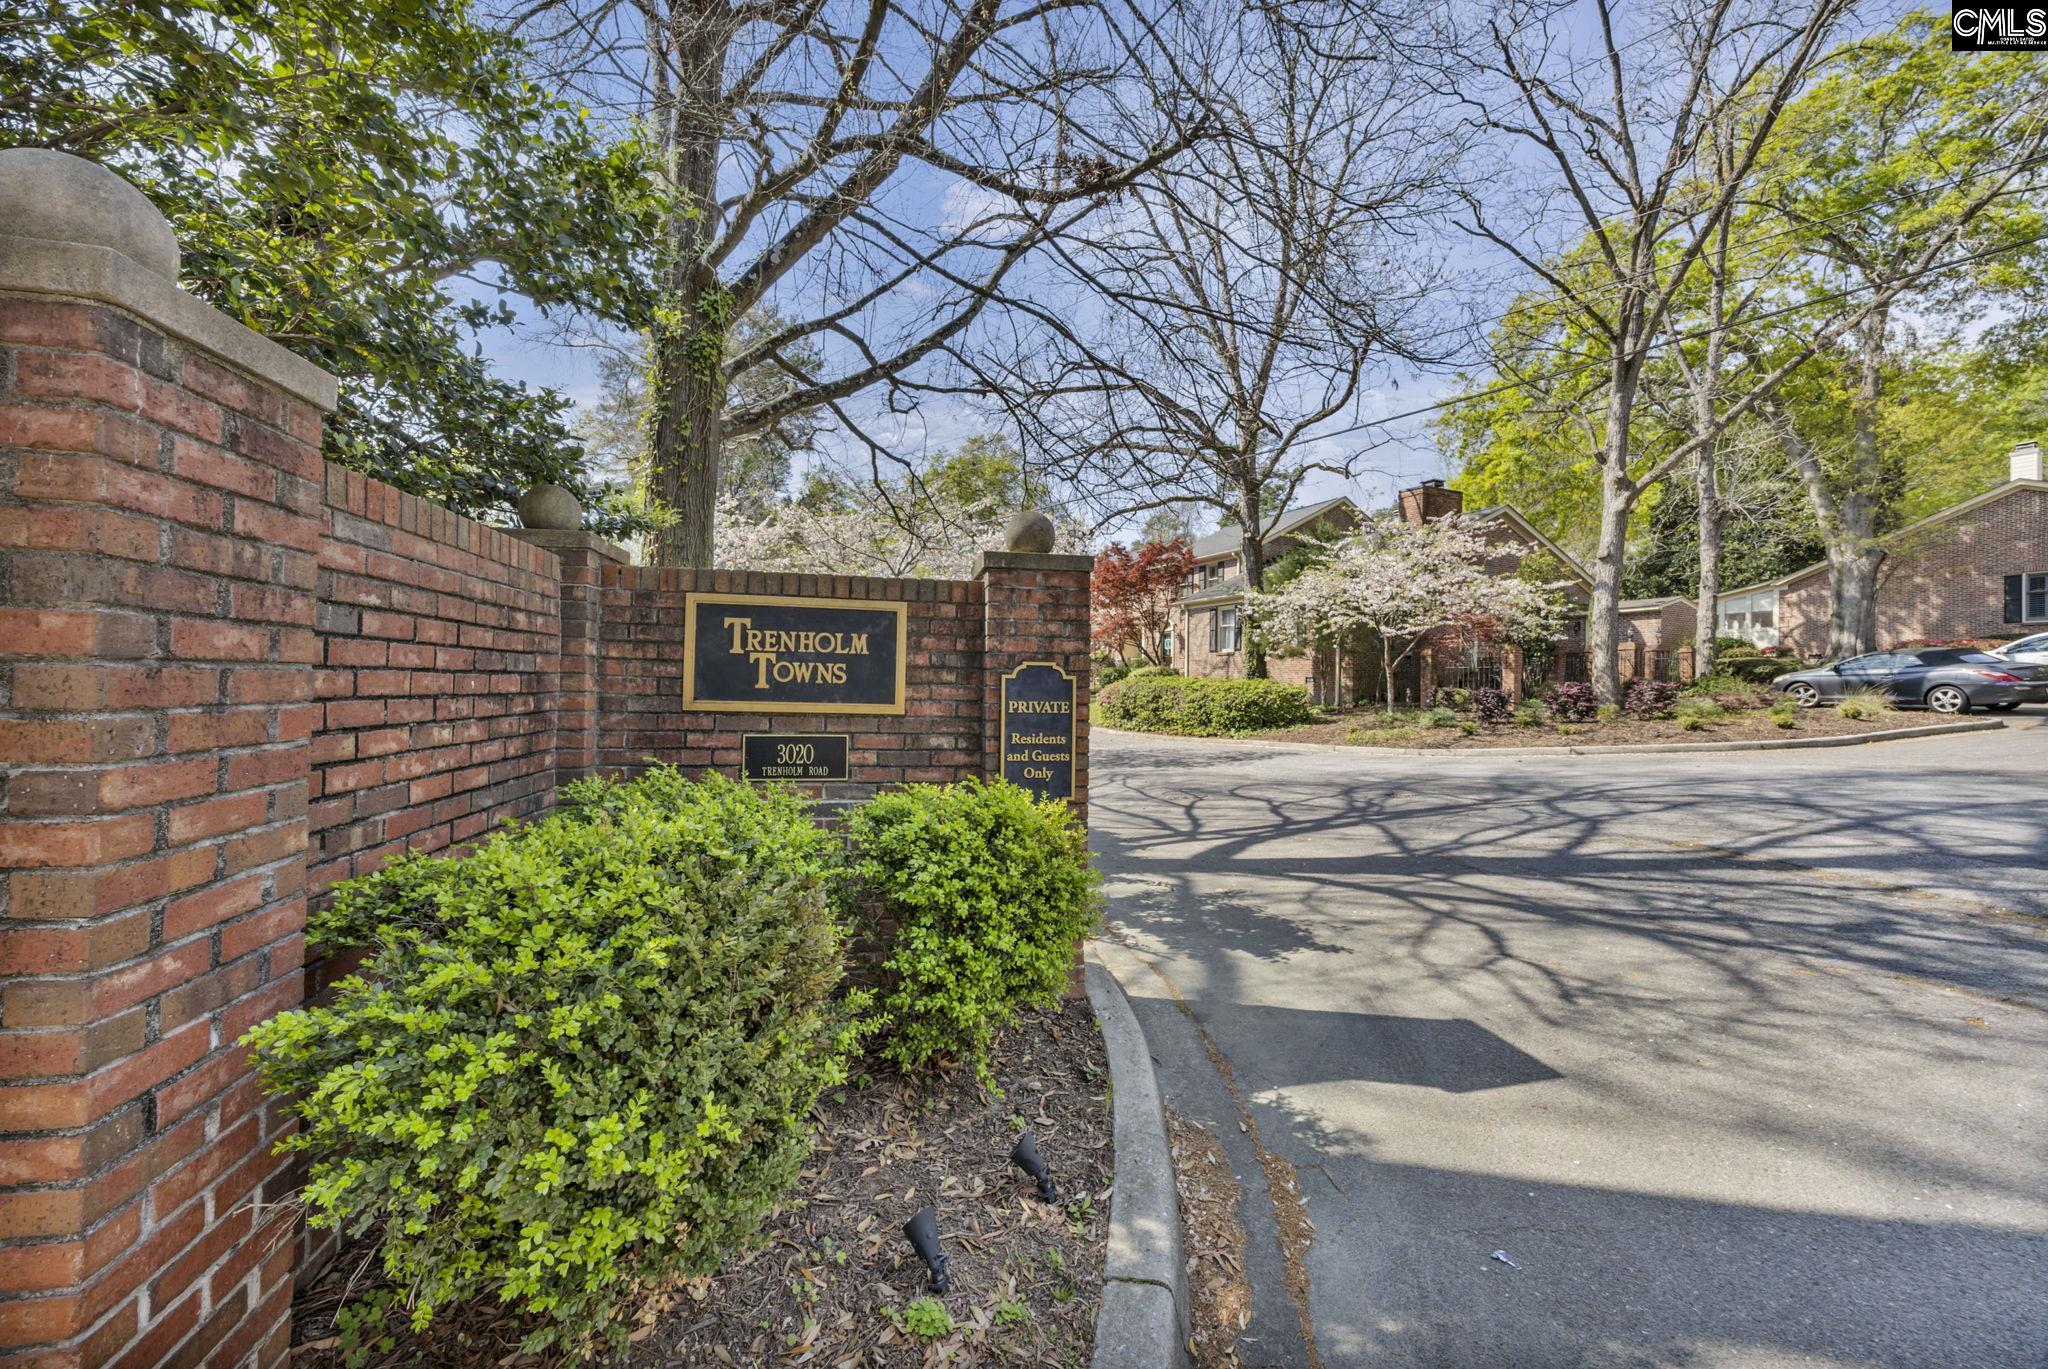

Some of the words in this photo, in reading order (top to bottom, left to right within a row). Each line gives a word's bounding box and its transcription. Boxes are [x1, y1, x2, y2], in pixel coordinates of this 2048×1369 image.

[723, 617, 869, 655] TRENHOLM
[750, 652, 848, 688] TOWNS
[1008, 700, 1070, 714] PRIVATE
[1010, 732, 1066, 744] Residents
[777, 743, 814, 764] 3020
[1006, 749, 1029, 761] and
[1032, 749, 1070, 761] Guests
[762, 766, 803, 776] TRENHOLM
[808, 766, 829, 776] ROAD
[1023, 766, 1054, 782] Only
